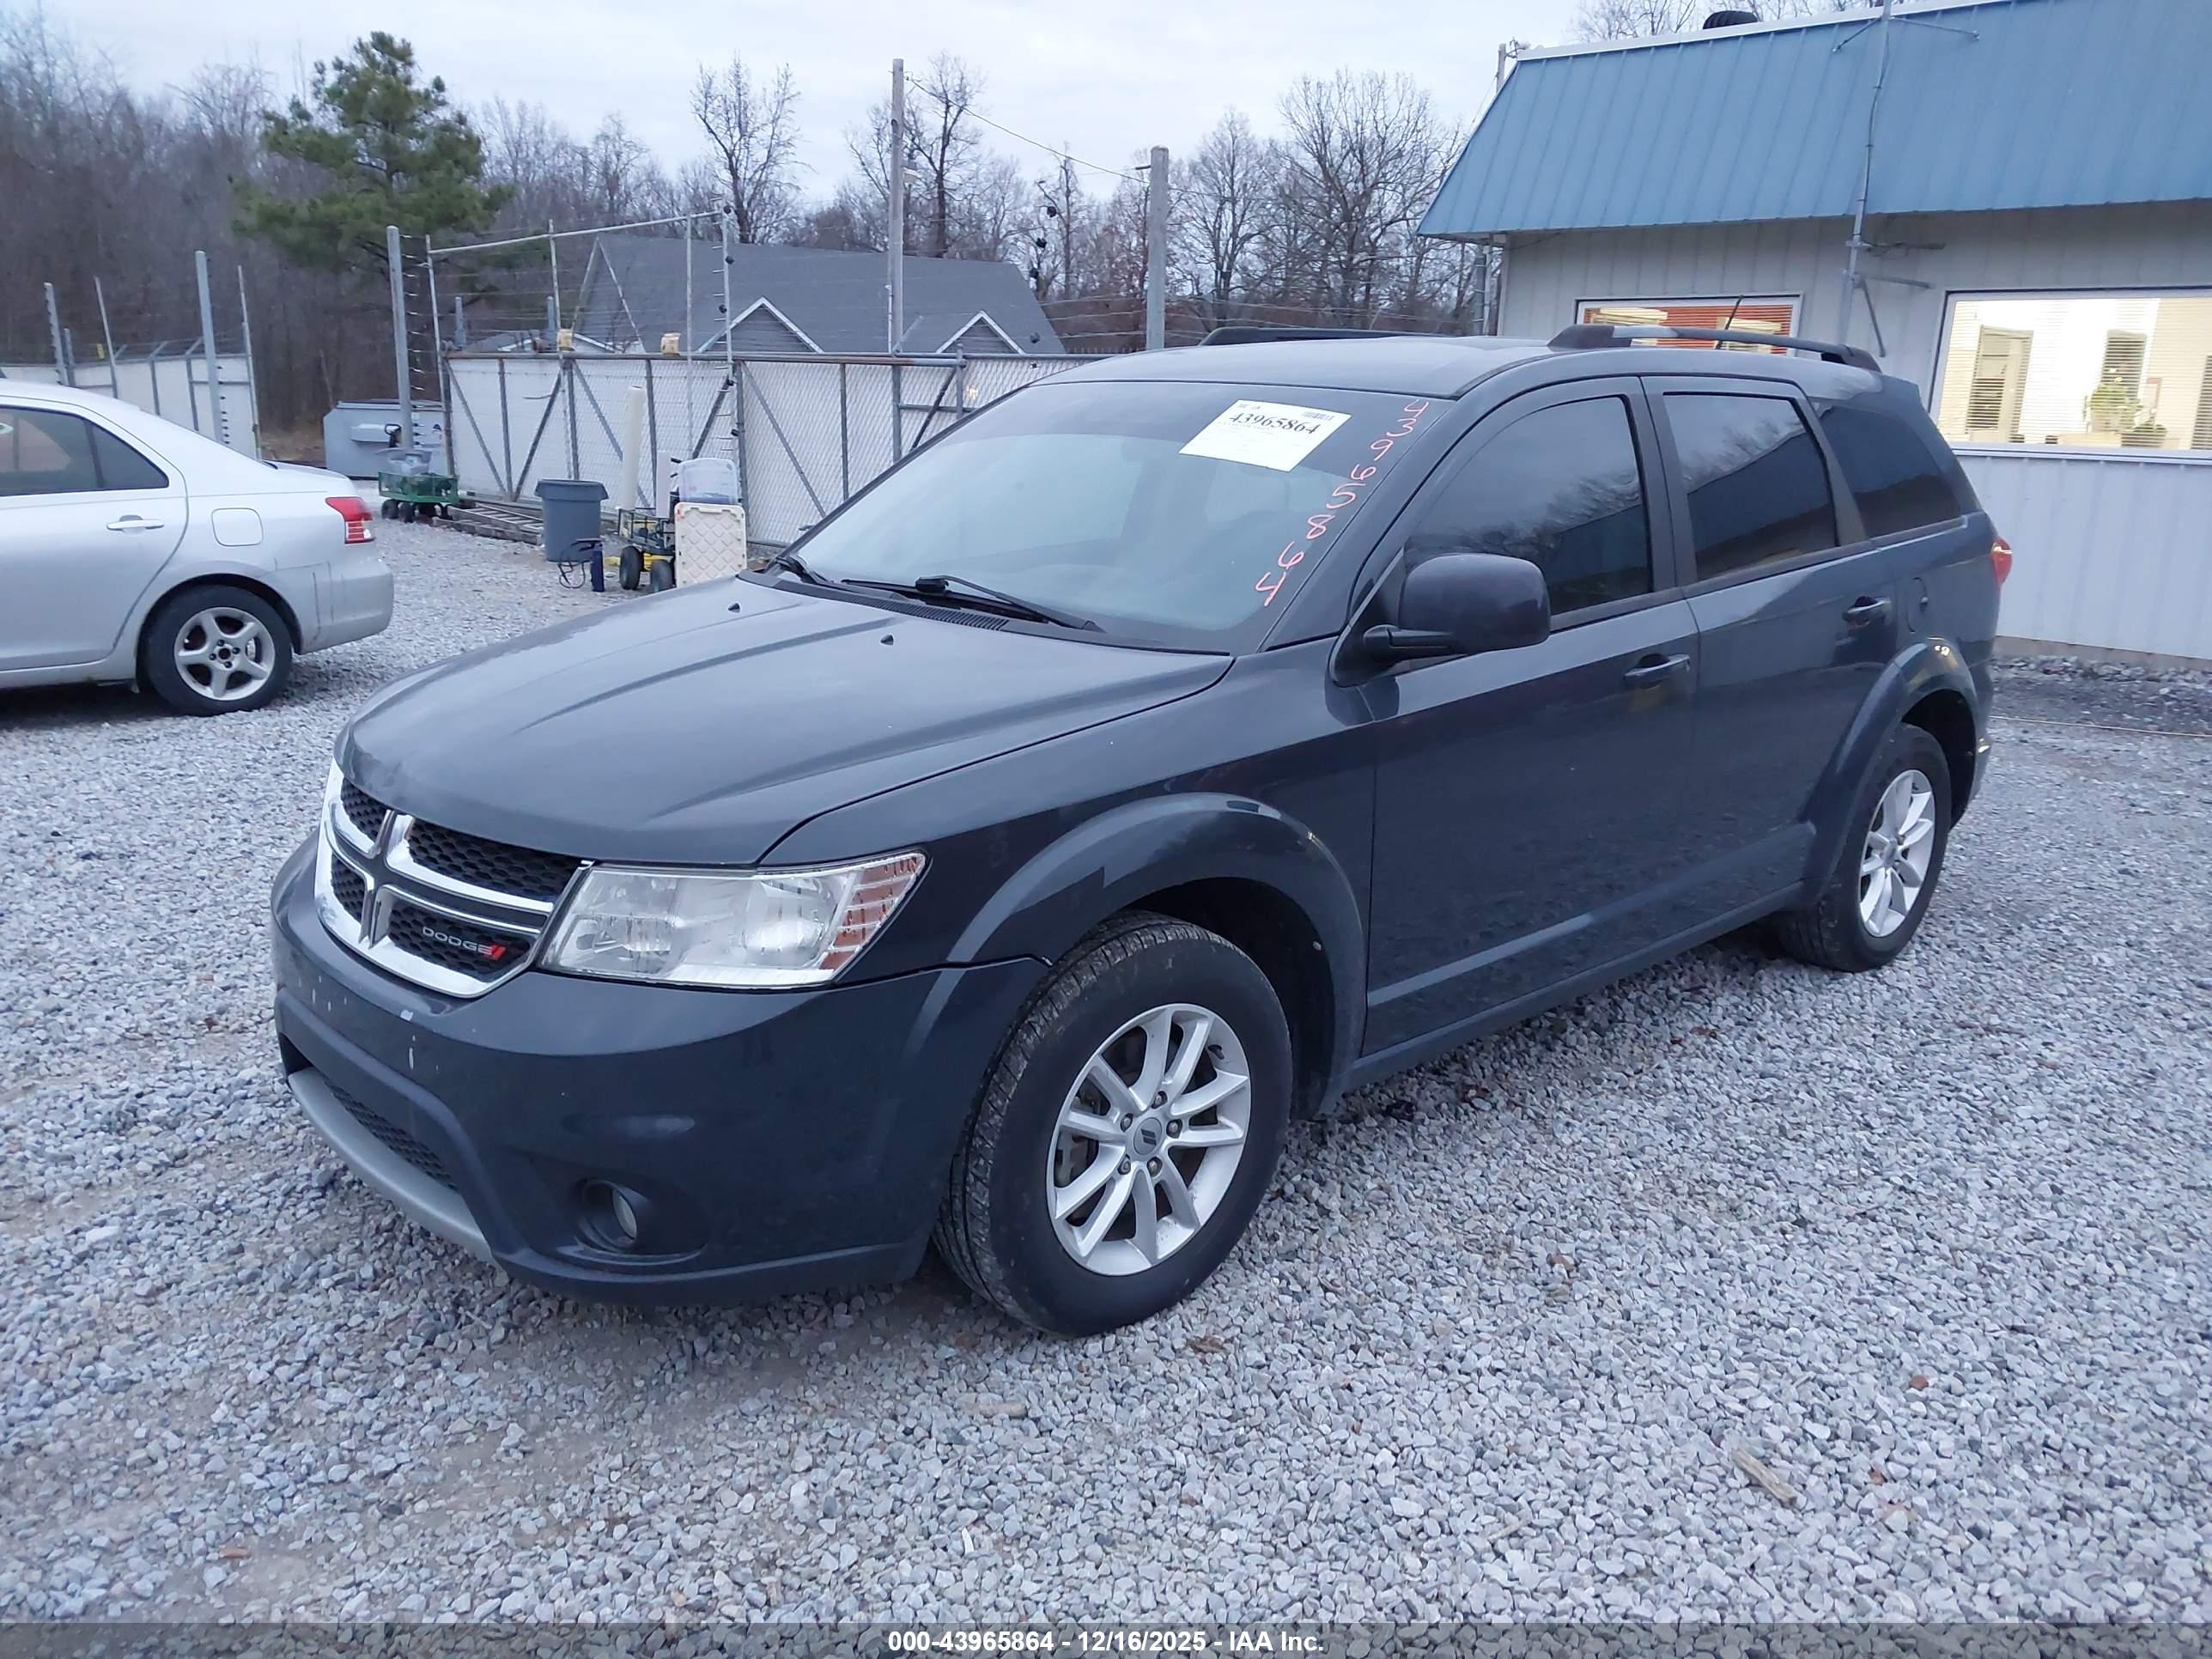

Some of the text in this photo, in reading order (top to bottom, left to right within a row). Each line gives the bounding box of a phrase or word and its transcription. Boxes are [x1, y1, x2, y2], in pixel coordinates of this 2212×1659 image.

[1229, 412, 1322, 434] 43965864
[1255, 398, 1430, 607] 43965864
[422, 927, 493, 956] DODGE
